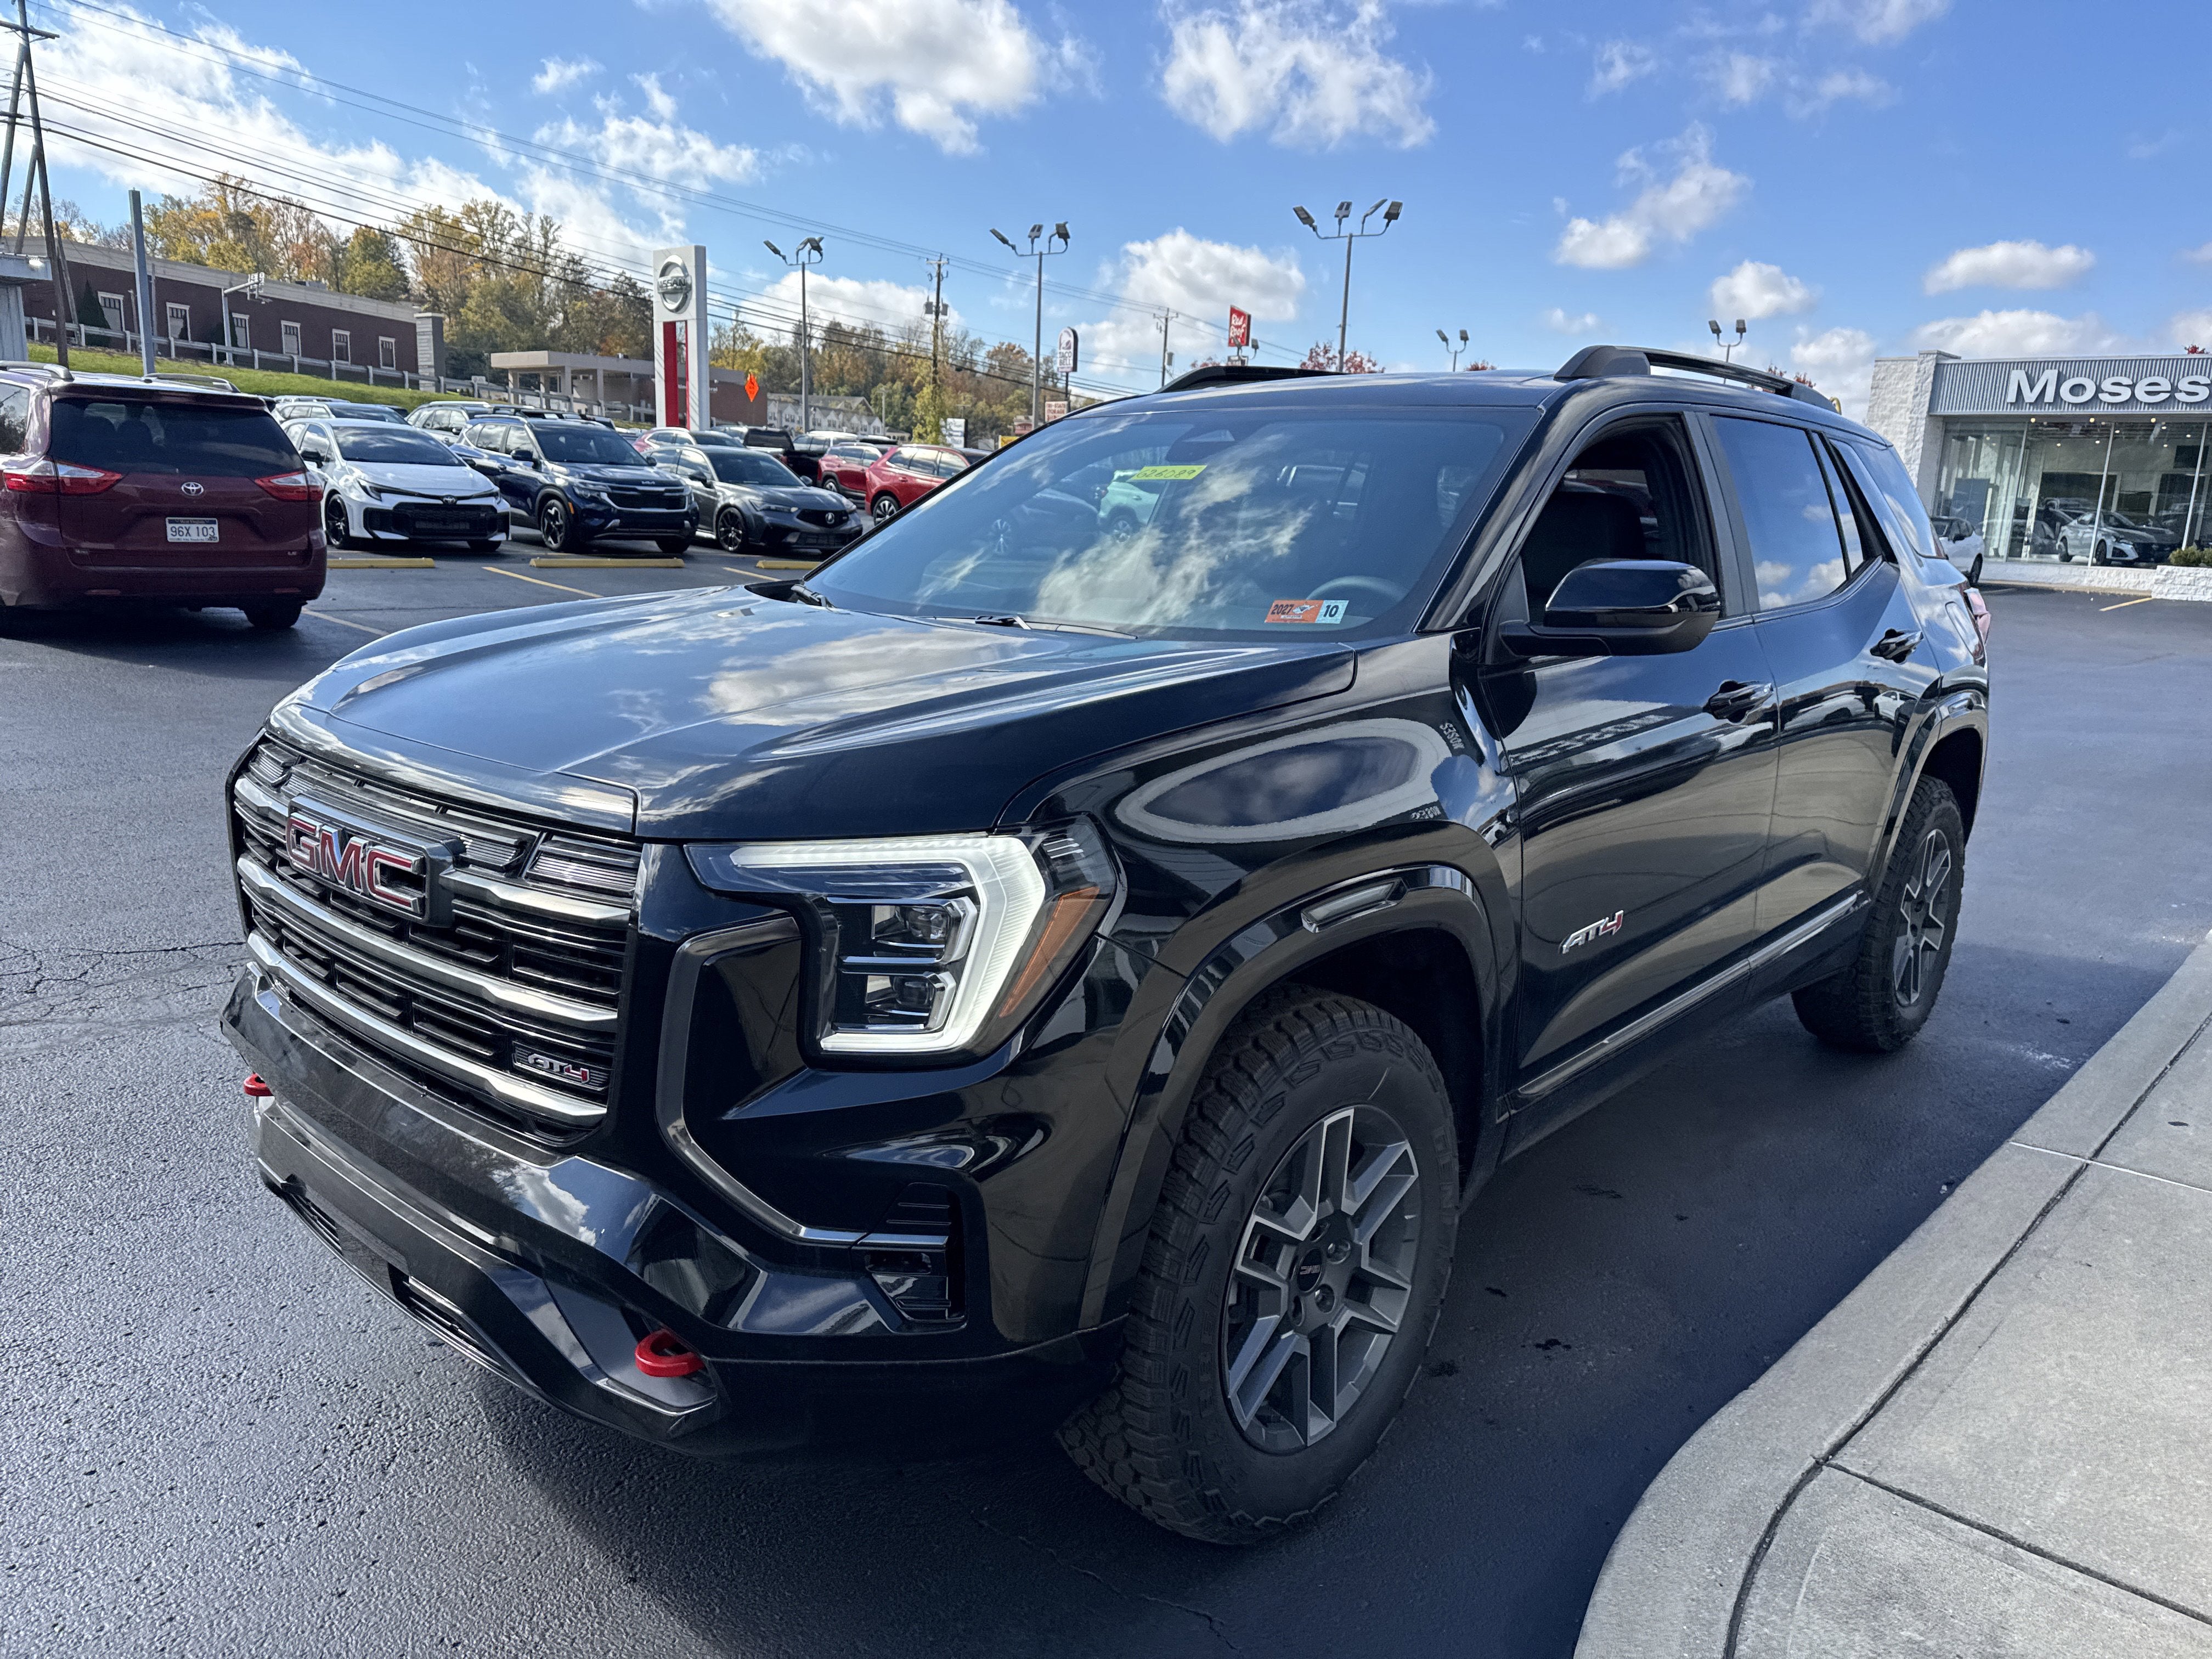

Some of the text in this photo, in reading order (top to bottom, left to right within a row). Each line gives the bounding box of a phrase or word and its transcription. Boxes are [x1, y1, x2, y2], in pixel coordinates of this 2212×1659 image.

[1231, 314, 1244, 325] Red
[2006, 369, 2211, 403] Moses
[171, 526, 216, 537] 96X 103
[1271, 604, 1339, 618] 2027 10
[286, 812, 425, 914] GMC
[1562, 910, 1624, 954] AT4
[528, 1053, 590, 1084] AT4
